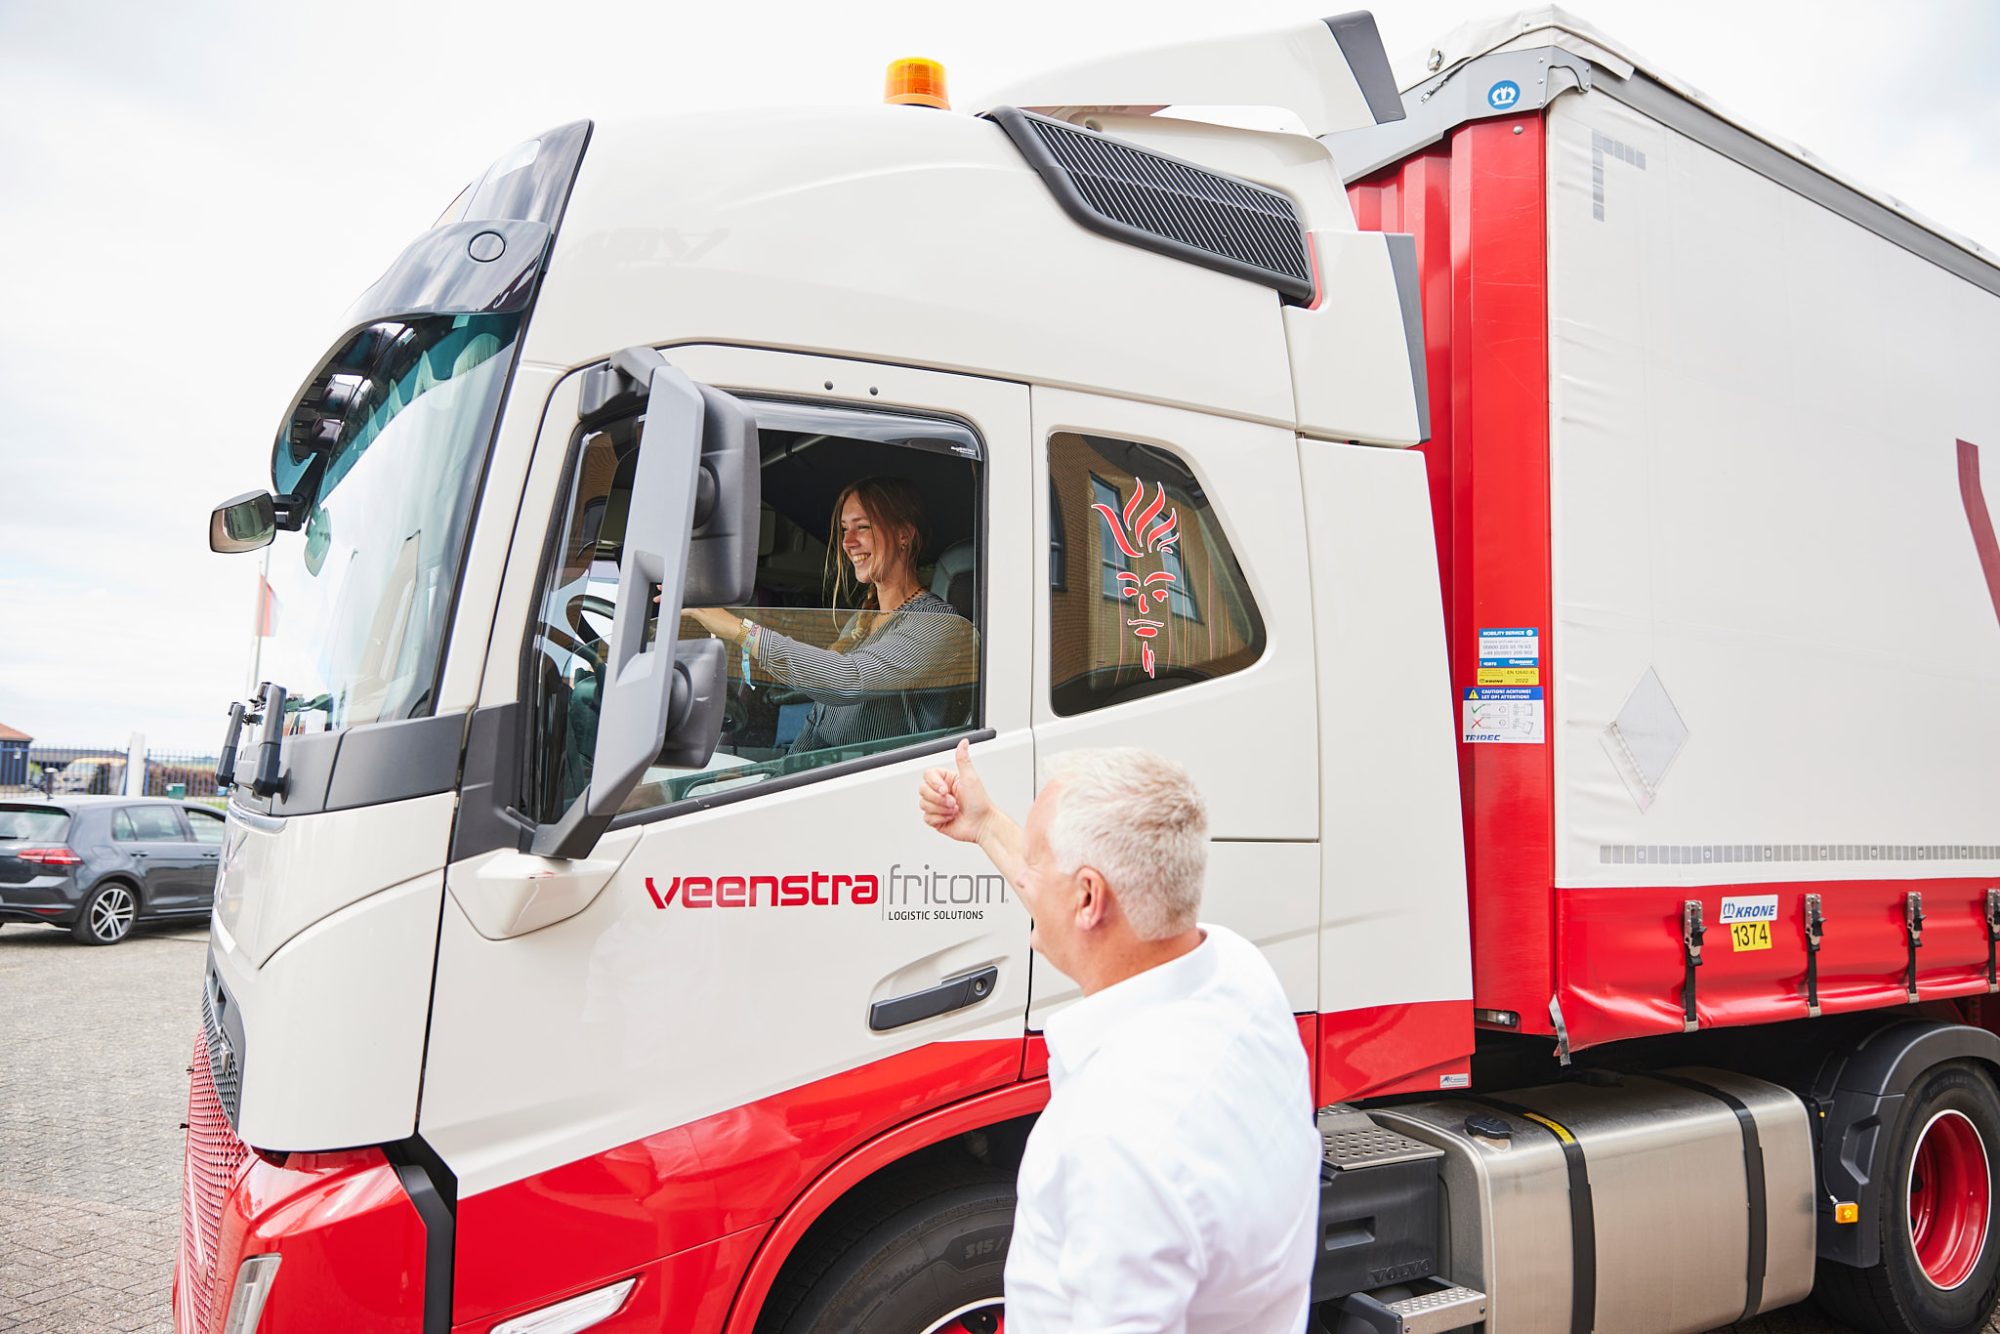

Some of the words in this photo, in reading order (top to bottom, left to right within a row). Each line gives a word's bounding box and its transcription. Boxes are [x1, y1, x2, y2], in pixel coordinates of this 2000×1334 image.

[645, 871, 879, 910] veenstra
[889, 864, 1005, 905] fritom
[888, 911, 930, 921] LOGISTIC
[933, 910, 984, 920] SOLUTIONS
[1736, 905, 1775, 918] KRONE
[1734, 924, 1768, 947] 1374
